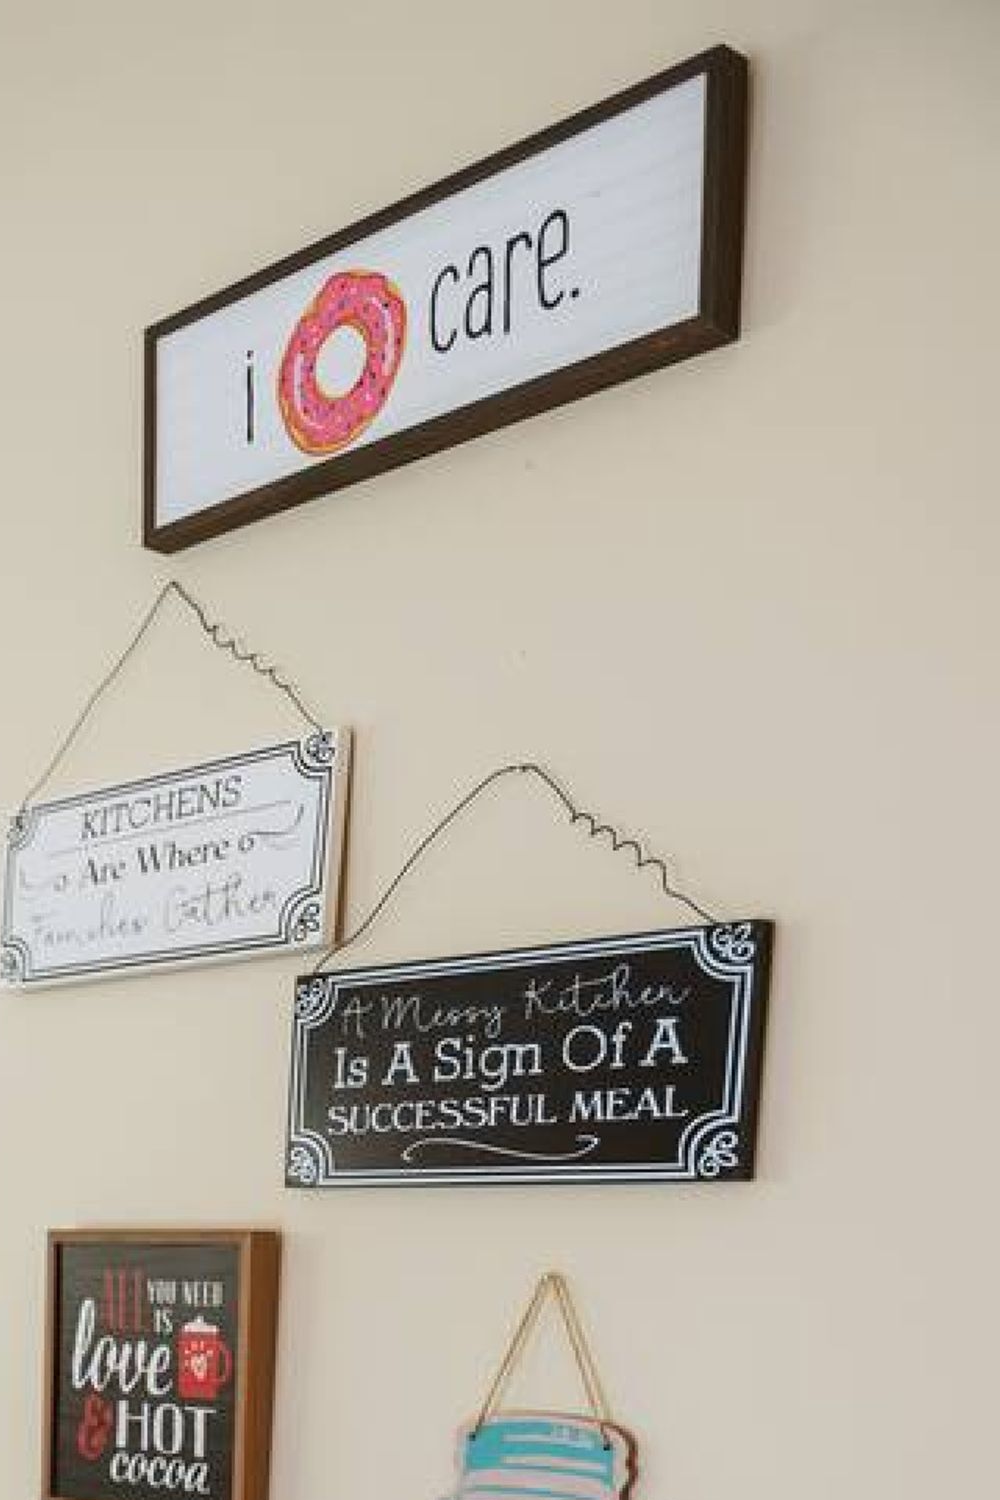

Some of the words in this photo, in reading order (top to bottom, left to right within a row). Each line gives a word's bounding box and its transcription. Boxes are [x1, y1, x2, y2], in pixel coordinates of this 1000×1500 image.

[428, 208, 581, 354] care.
[81, 775, 242, 840] KITCHENS
[136, 840, 230, 874] Where
[341, 997, 374, 1039] A
[523, 963, 692, 1021] Kitchen
[333, 1046, 369, 1090] Is
[381, 1041, 420, 1086] A
[432, 1036, 542, 1091] Sign
[562, 1020, 633, 1072] Of
[640, 1016, 689, 1067] A
[327, 1093, 559, 1136] SUCCESSFUL
[568, 1085, 689, 1123] MEAL
[71, 1296, 173, 1396] love
[152, 1308, 174, 1334] IS
[114, 1399, 217, 1459] HOT
[108, 1450, 210, 1496] cocoa
